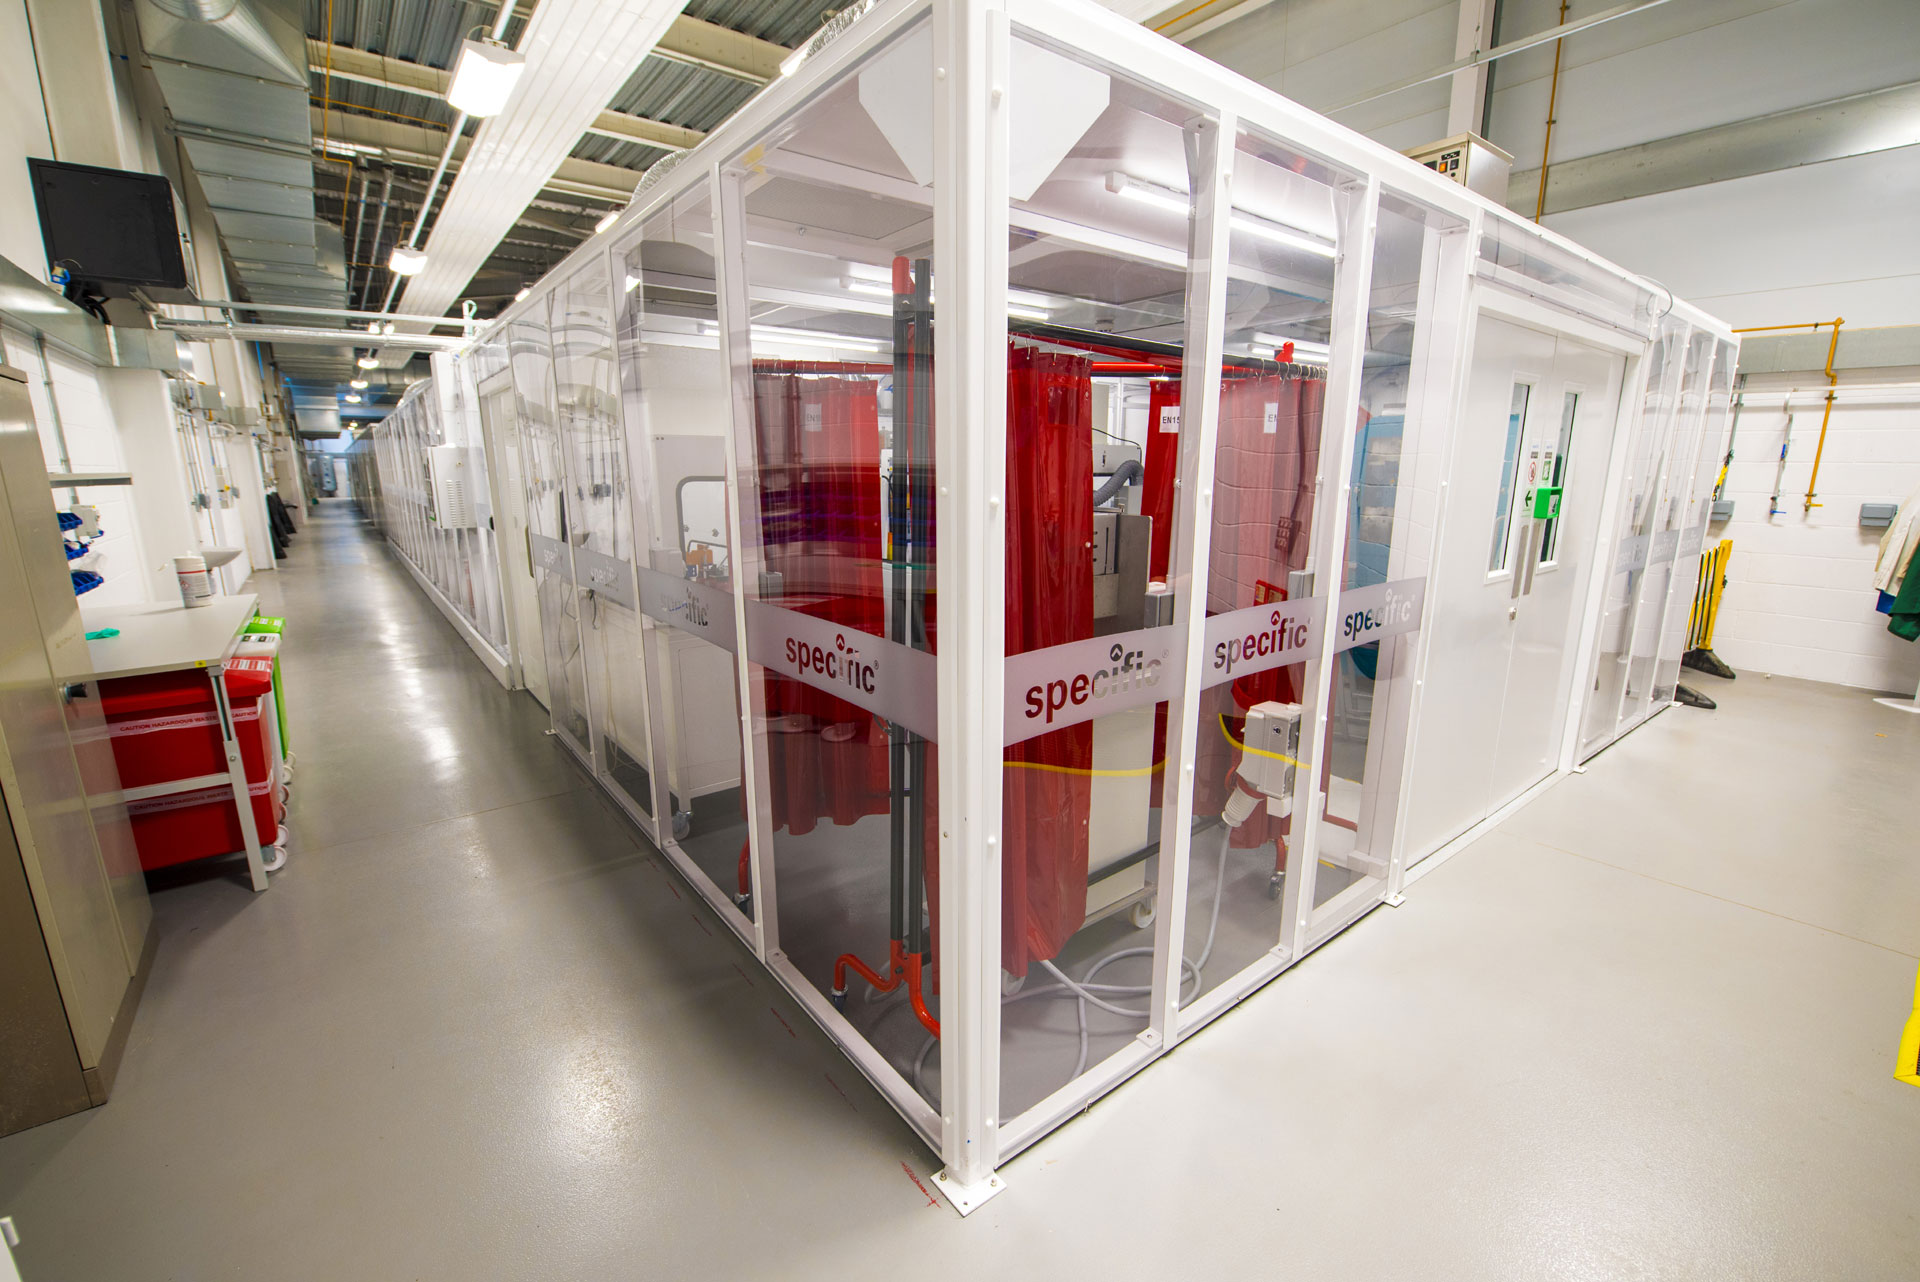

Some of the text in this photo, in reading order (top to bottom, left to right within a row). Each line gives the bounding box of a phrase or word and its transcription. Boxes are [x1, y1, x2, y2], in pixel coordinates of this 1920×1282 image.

[1214, 610, 1308, 674] specific
[1344, 588, 1412, 641] specific
[785, 633, 876, 695] specific
[1025, 643, 1162, 724] specific
[120, 724, 150, 732] CAUTION
[152, 718, 193, 728] HAZARDOUS
